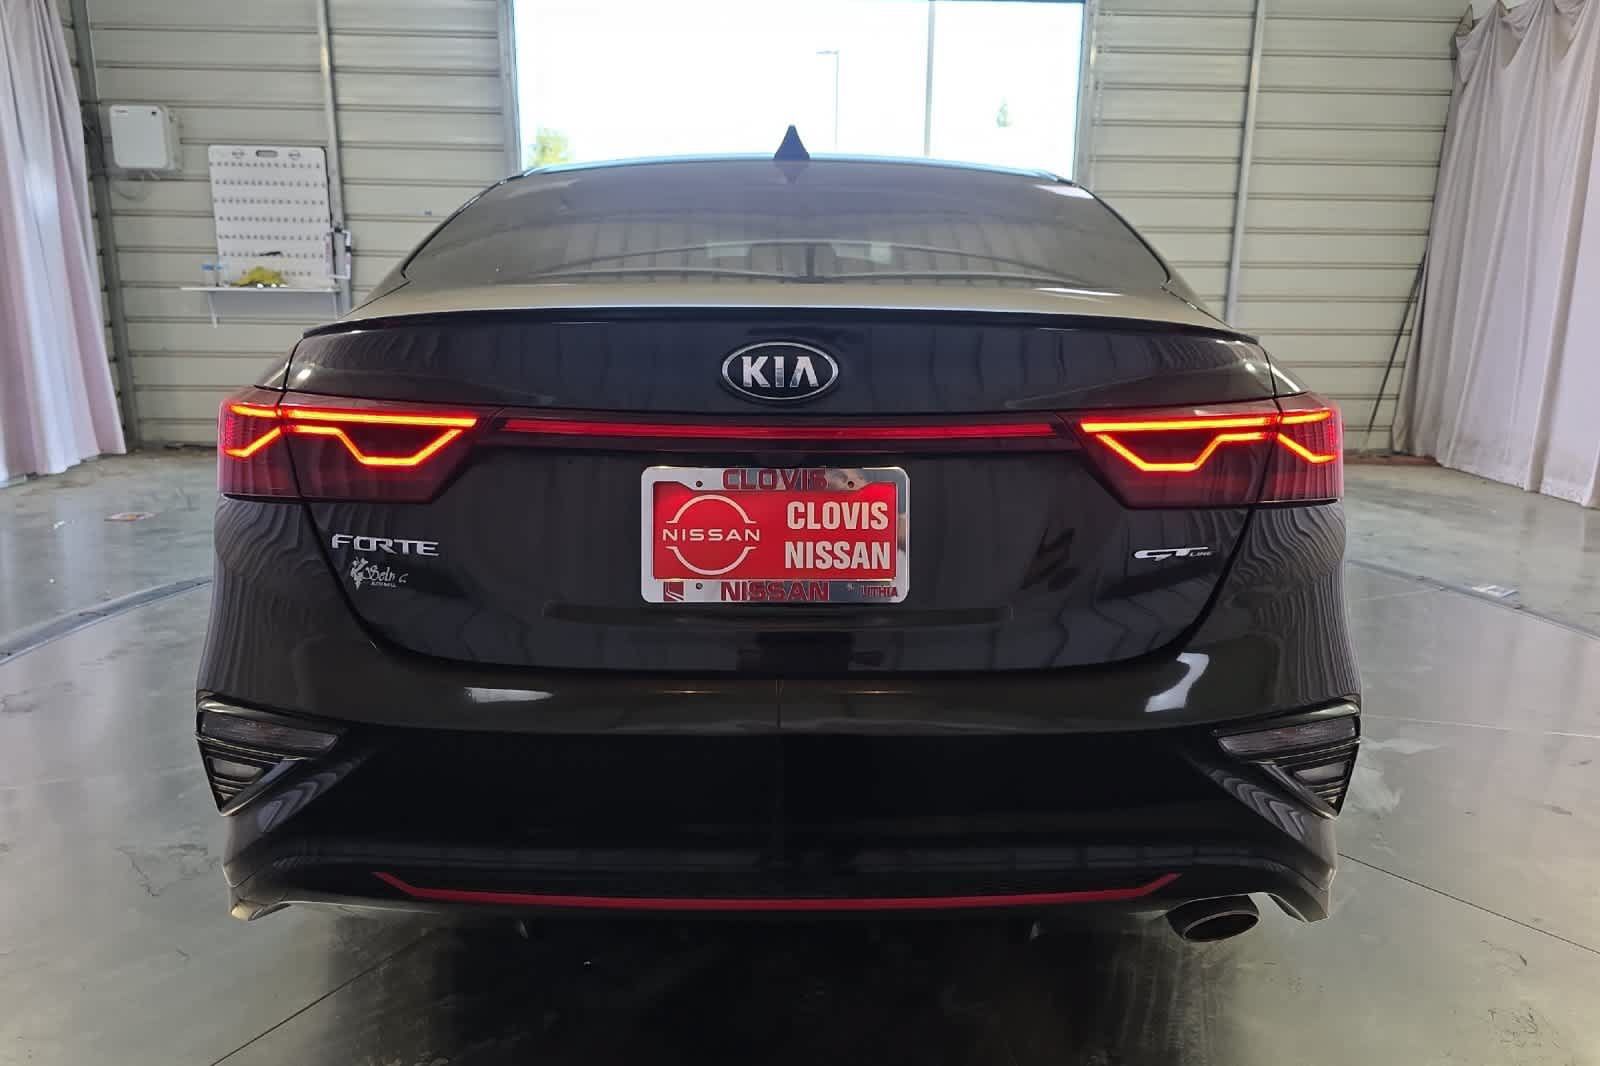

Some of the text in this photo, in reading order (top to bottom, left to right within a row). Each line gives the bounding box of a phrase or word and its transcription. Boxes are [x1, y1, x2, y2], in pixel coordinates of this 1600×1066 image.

[741, 356, 819, 388] KIA
[723, 469, 828, 490] CLOVIS
[787, 501, 889, 530] CLOVIS
[331, 533, 440, 556] FORTE
[662, 528, 761, 542] NISSAN
[785, 541, 890, 570] NISSAN
[1134, 546, 1209, 561] GT
[720, 581, 829, 601] NISSAN
